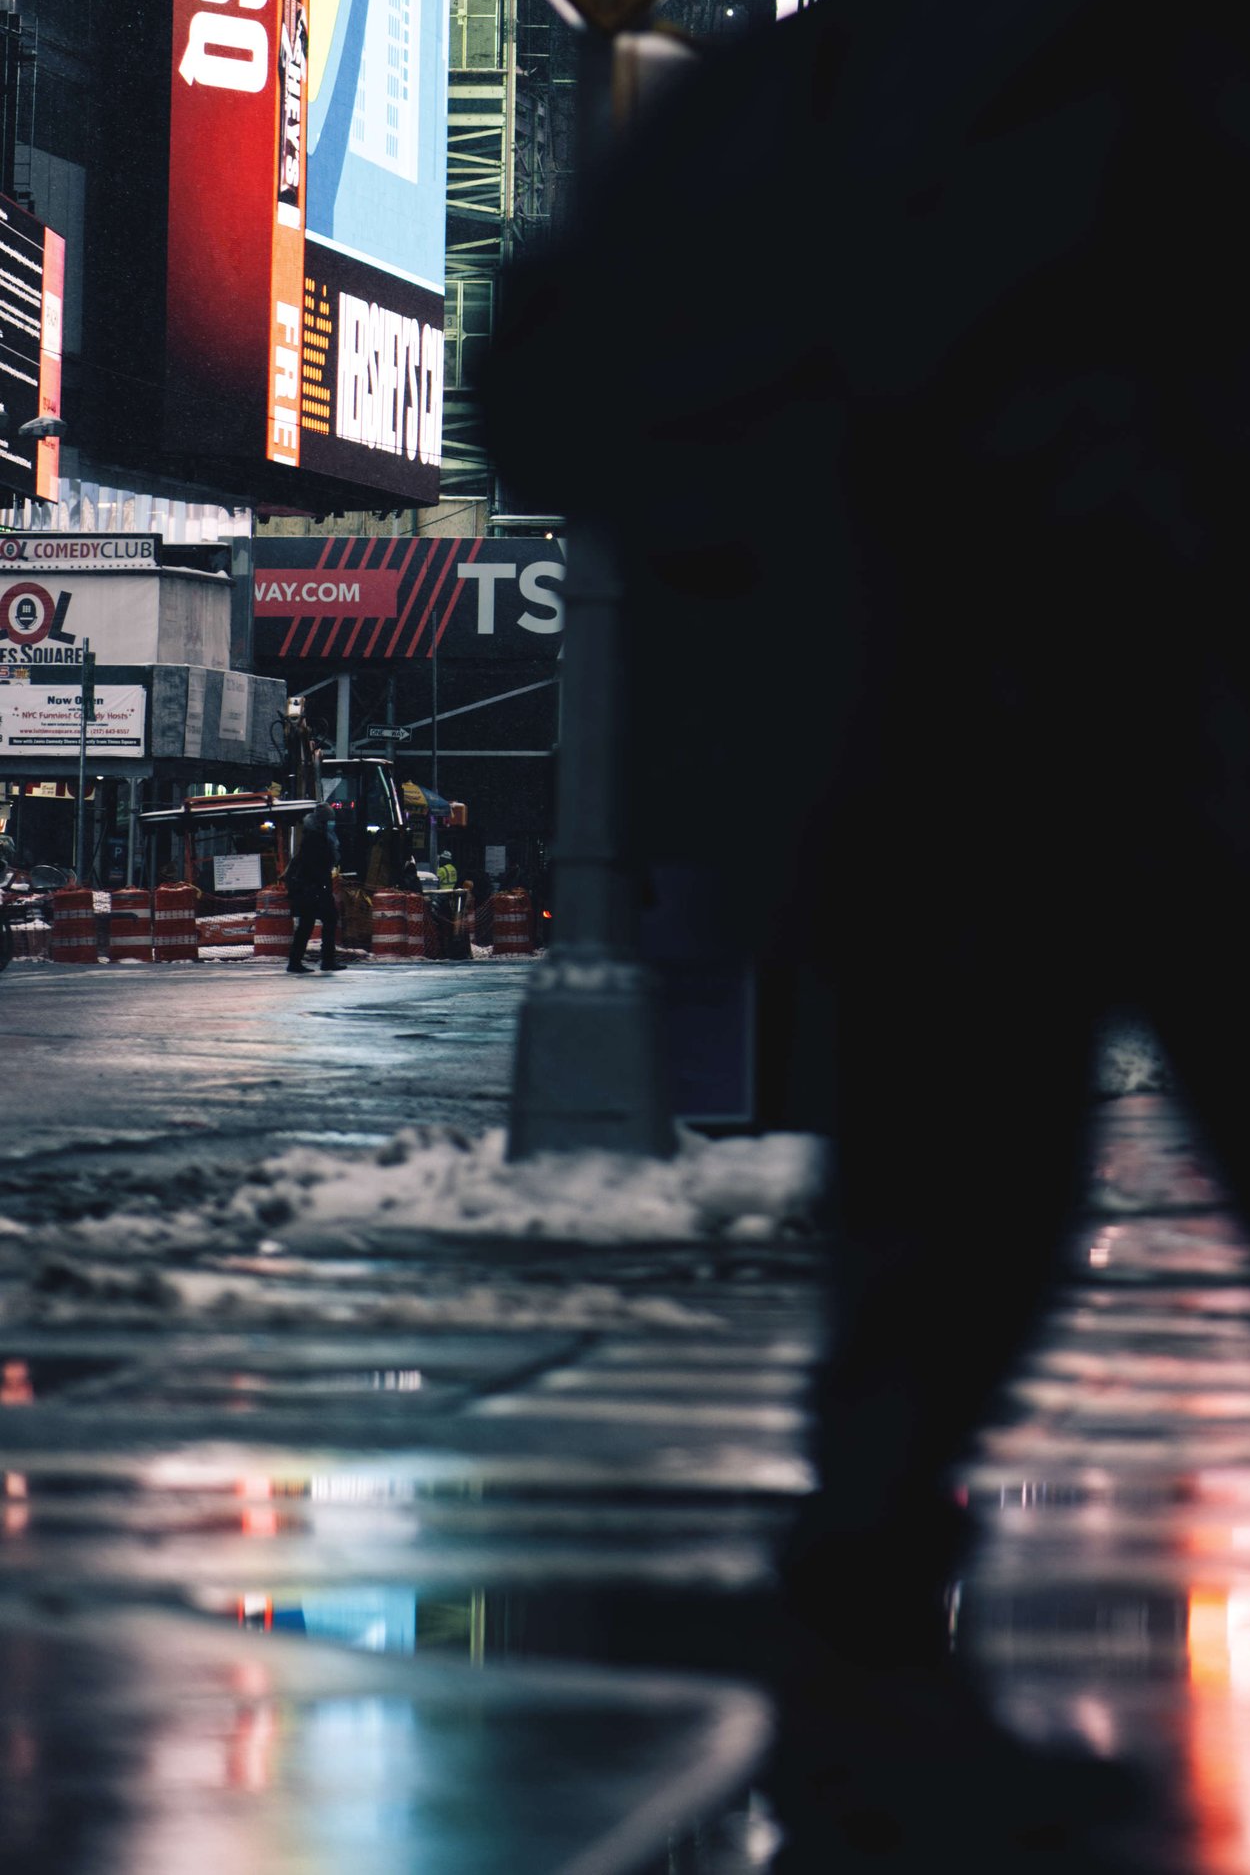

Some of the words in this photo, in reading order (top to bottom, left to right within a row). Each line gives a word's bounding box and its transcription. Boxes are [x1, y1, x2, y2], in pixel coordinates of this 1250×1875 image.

[336, 291, 420, 462] HERSHEY'S
[273, 300, 300, 467] FRE
[47, 695, 73, 706] Now
[74, 695, 104, 706] On
[22, 711, 38, 720] NYC
[39, 711, 72, 720] Funniest
[73, 711, 104, 722] Cody
[107, 711, 129, 720] Hosts
[370, 729, 385, 737] ONE
[392, 730, 406, 738] WAY
